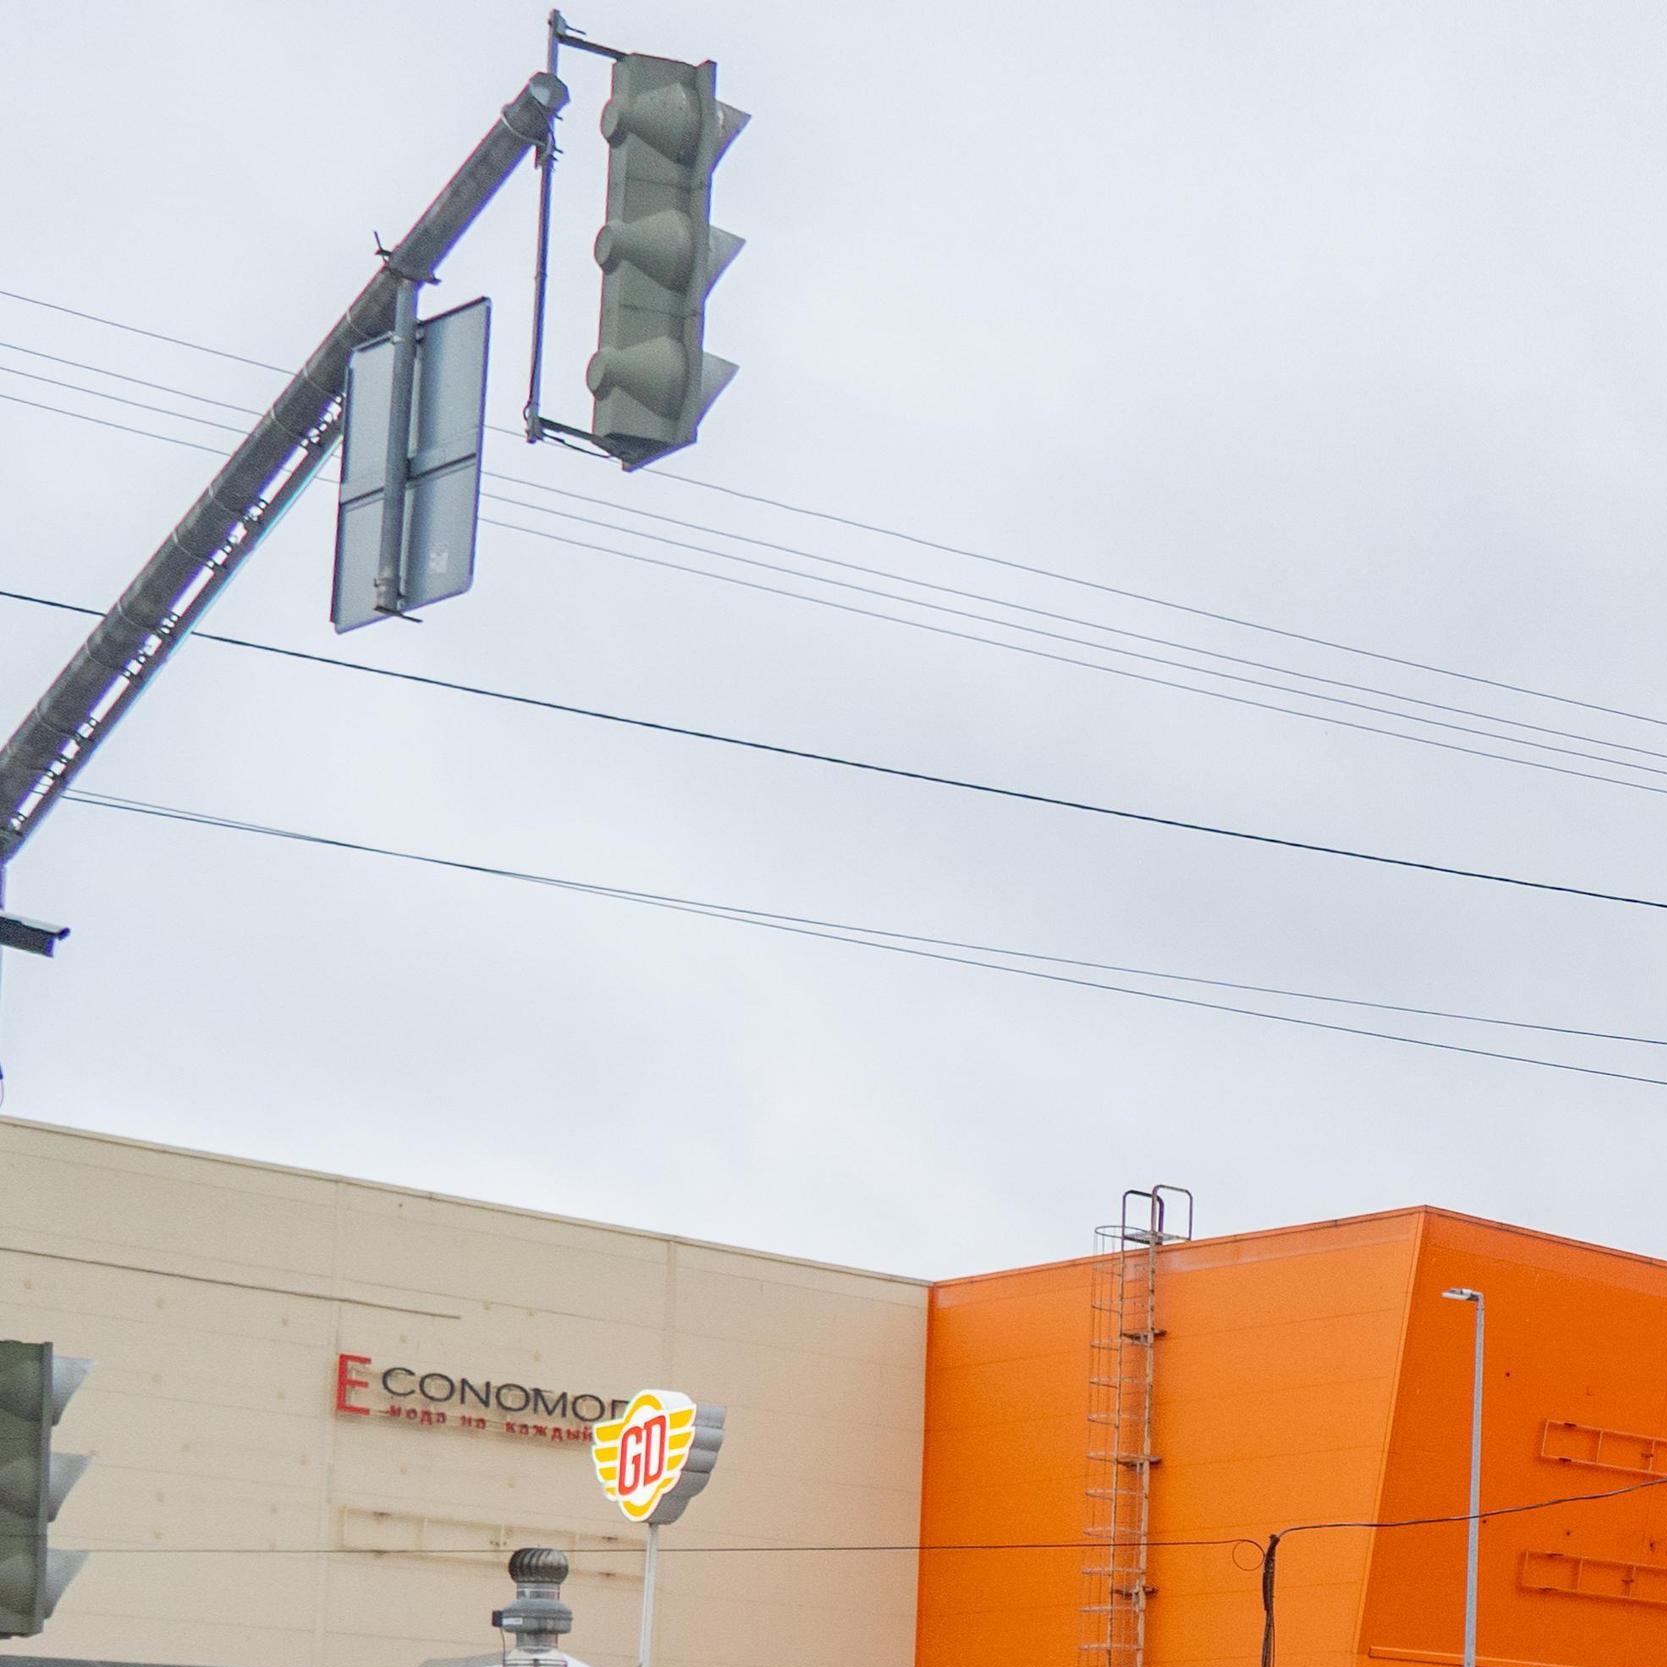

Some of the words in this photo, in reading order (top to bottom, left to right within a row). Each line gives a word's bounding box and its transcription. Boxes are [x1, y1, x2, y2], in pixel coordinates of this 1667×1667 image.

[388, 1404, 447, 1427] мода
[460, 1415, 486, 1431] на
[618, 1415, 667, 1497] GD
